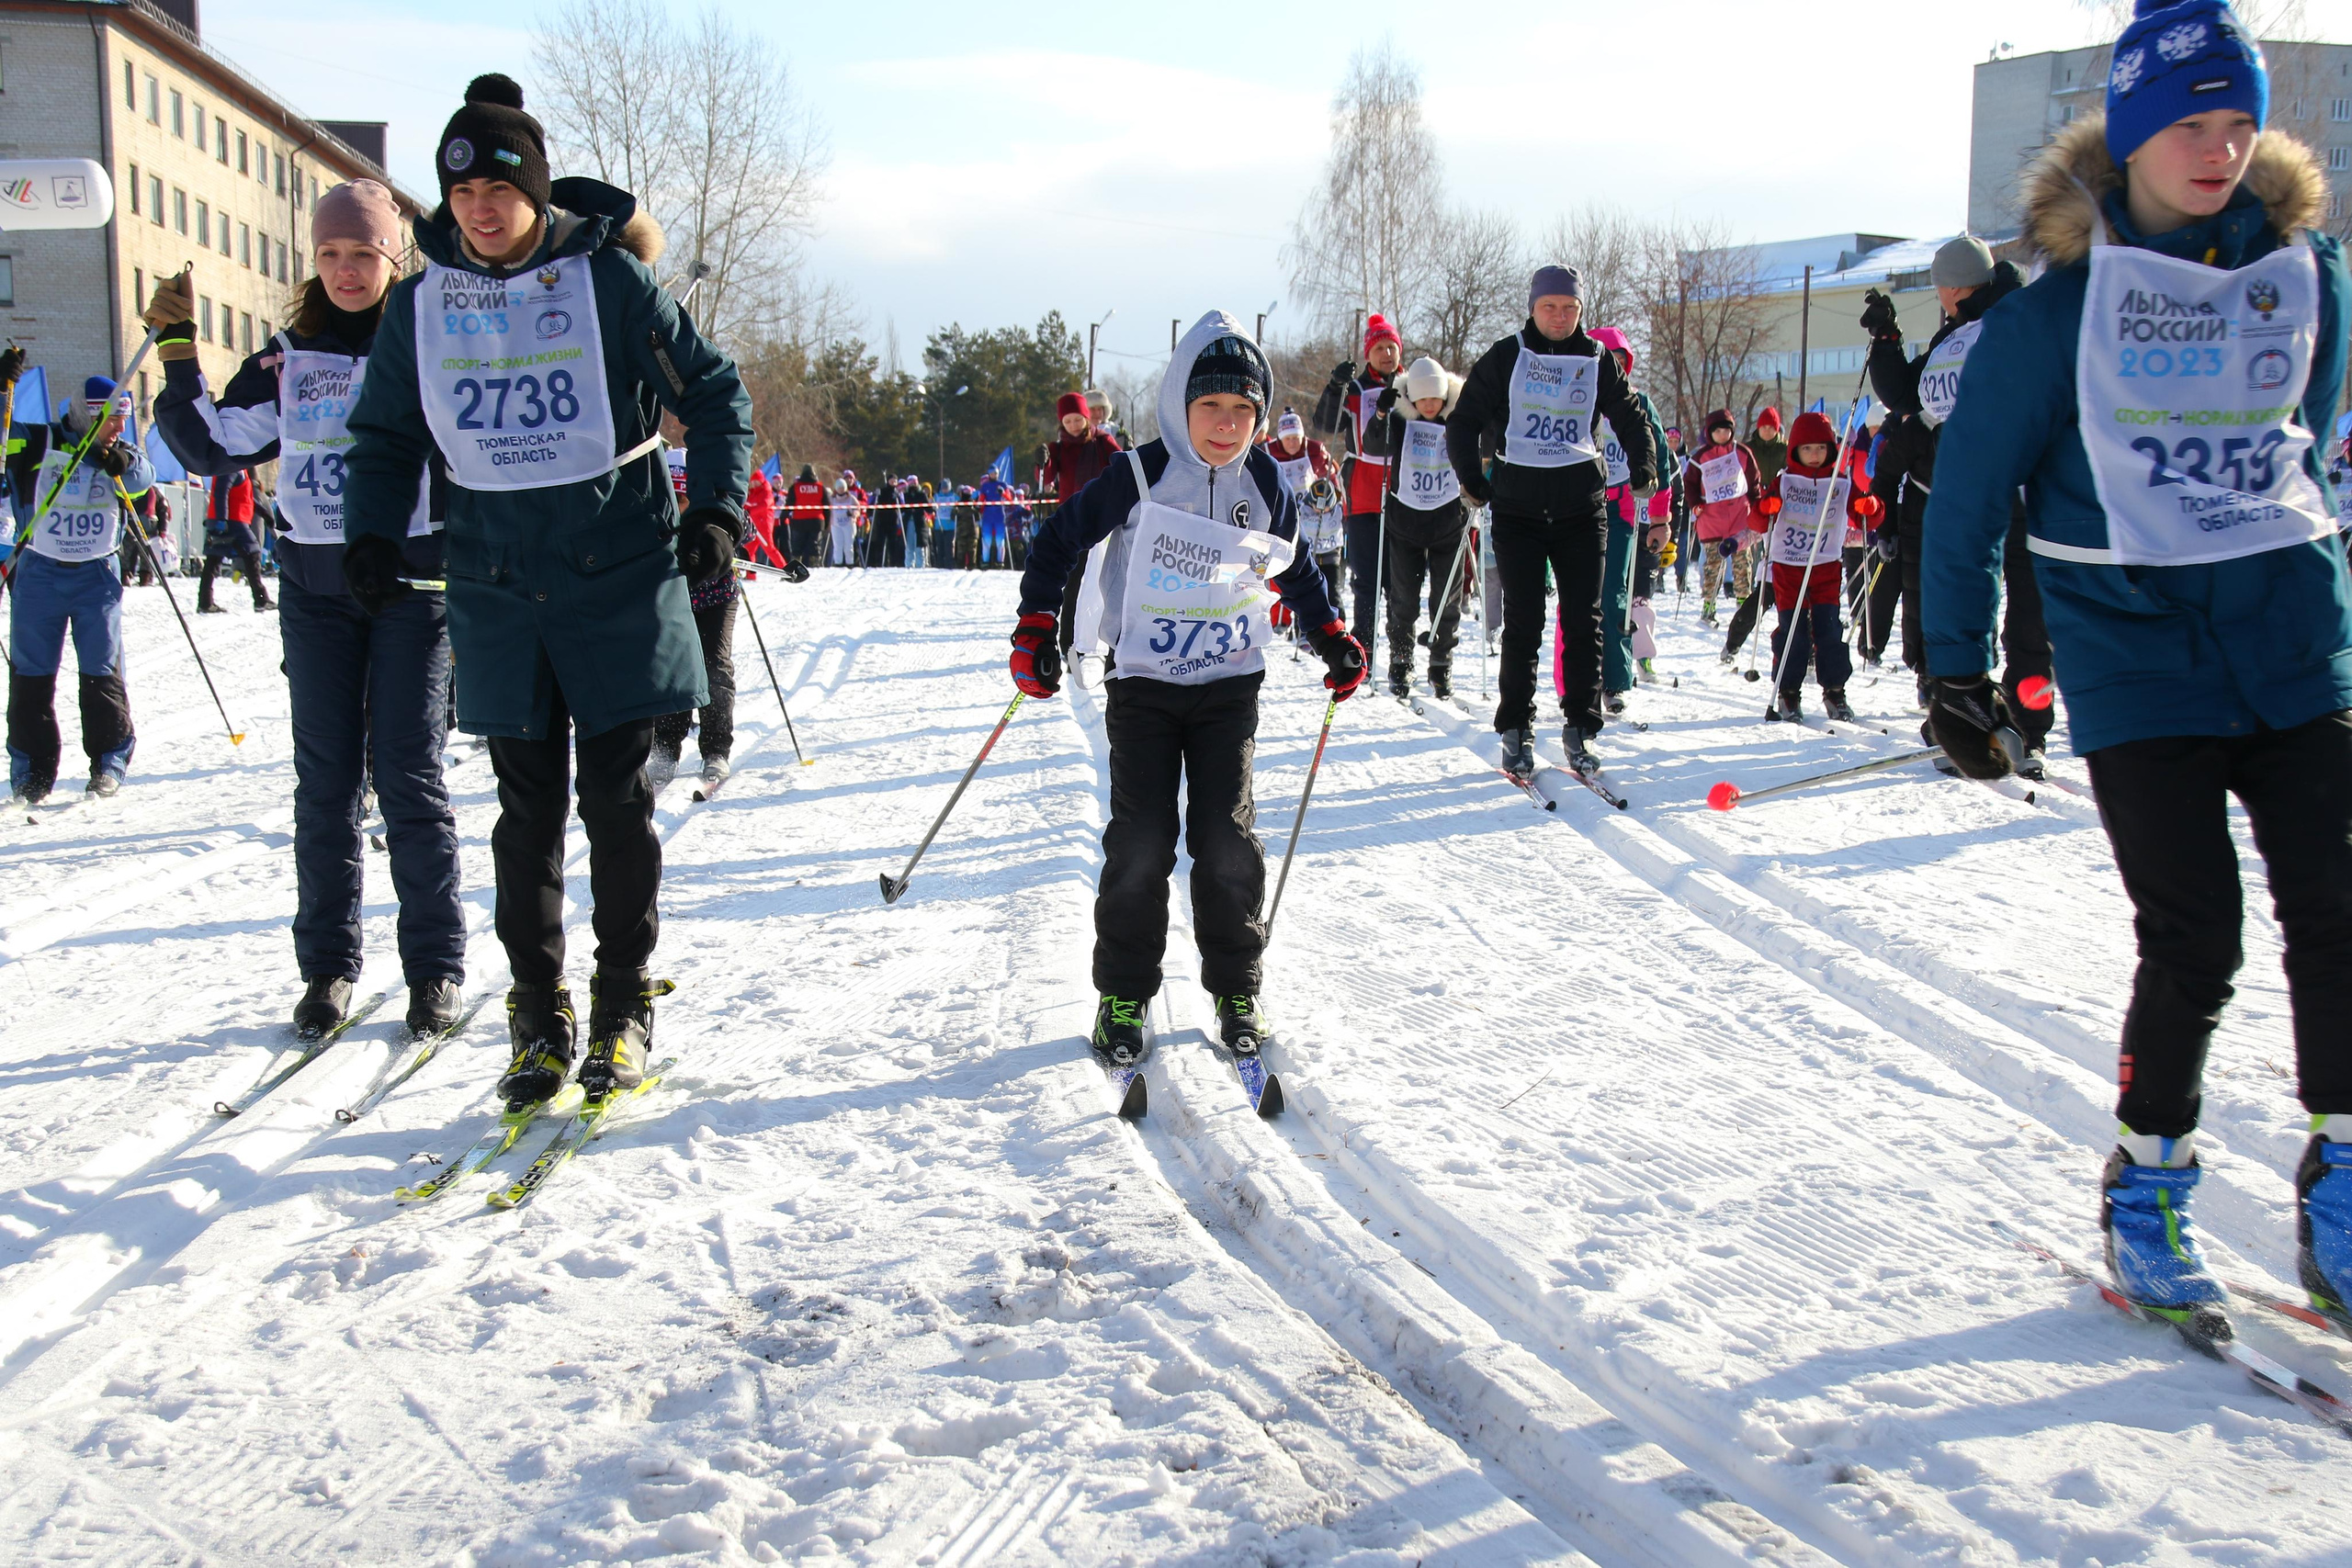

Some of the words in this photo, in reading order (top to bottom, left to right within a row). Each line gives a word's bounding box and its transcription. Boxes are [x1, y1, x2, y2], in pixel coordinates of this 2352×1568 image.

[444, 291, 507, 310] РОССИИ
[445, 312, 510, 335] 2023
[2119, 319, 2226, 343] РОССИИ
[442, 357, 481, 371] СПОРТ
[490, 355, 534, 370] НОРМА
[534, 347, 583, 367] ЖИЗНИ
[2117, 347, 2223, 378] 2023
[299, 369, 352, 387] ЛЫЖНЯ
[1525, 382, 1560, 398] 2023
[1526, 370, 1562, 386] РОССИИ
[1923, 371, 1958, 403] 3210
[299, 383, 350, 401] РОССИИ
[454, 369, 580, 431] 2738
[1523, 413, 1578, 444] 2658
[2115, 408, 2171, 426] СПОРТ
[476, 432, 566, 451] ТЮМЕНСКАЯ
[1538, 447, 1570, 456] ОБЛАСТЬ
[492, 448, 557, 467] ОБЛАСТЬ
[2131, 429, 2286, 492] 2359
[1786, 493, 1816, 505] РОССИИ
[48, 511, 105, 536] 2199
[2199, 505, 2284, 532] ОБЛАСТЬ
[55, 538, 96, 547] ТЮМЕНСКАЯ
[1153, 533, 1222, 564] ЛЫЖНЯ
[1782, 526, 1829, 553] 3371
[1151, 548, 1220, 583] РОССИИ
[1141, 604, 1177, 615] СПОРТ
[1186, 606, 1230, 618] НОРМА
[1229, 594, 1259, 615] ЖИЗНИ
[1149, 614, 1251, 660] 3733
[1170, 655, 1225, 675] ОБЛАСТЬ
